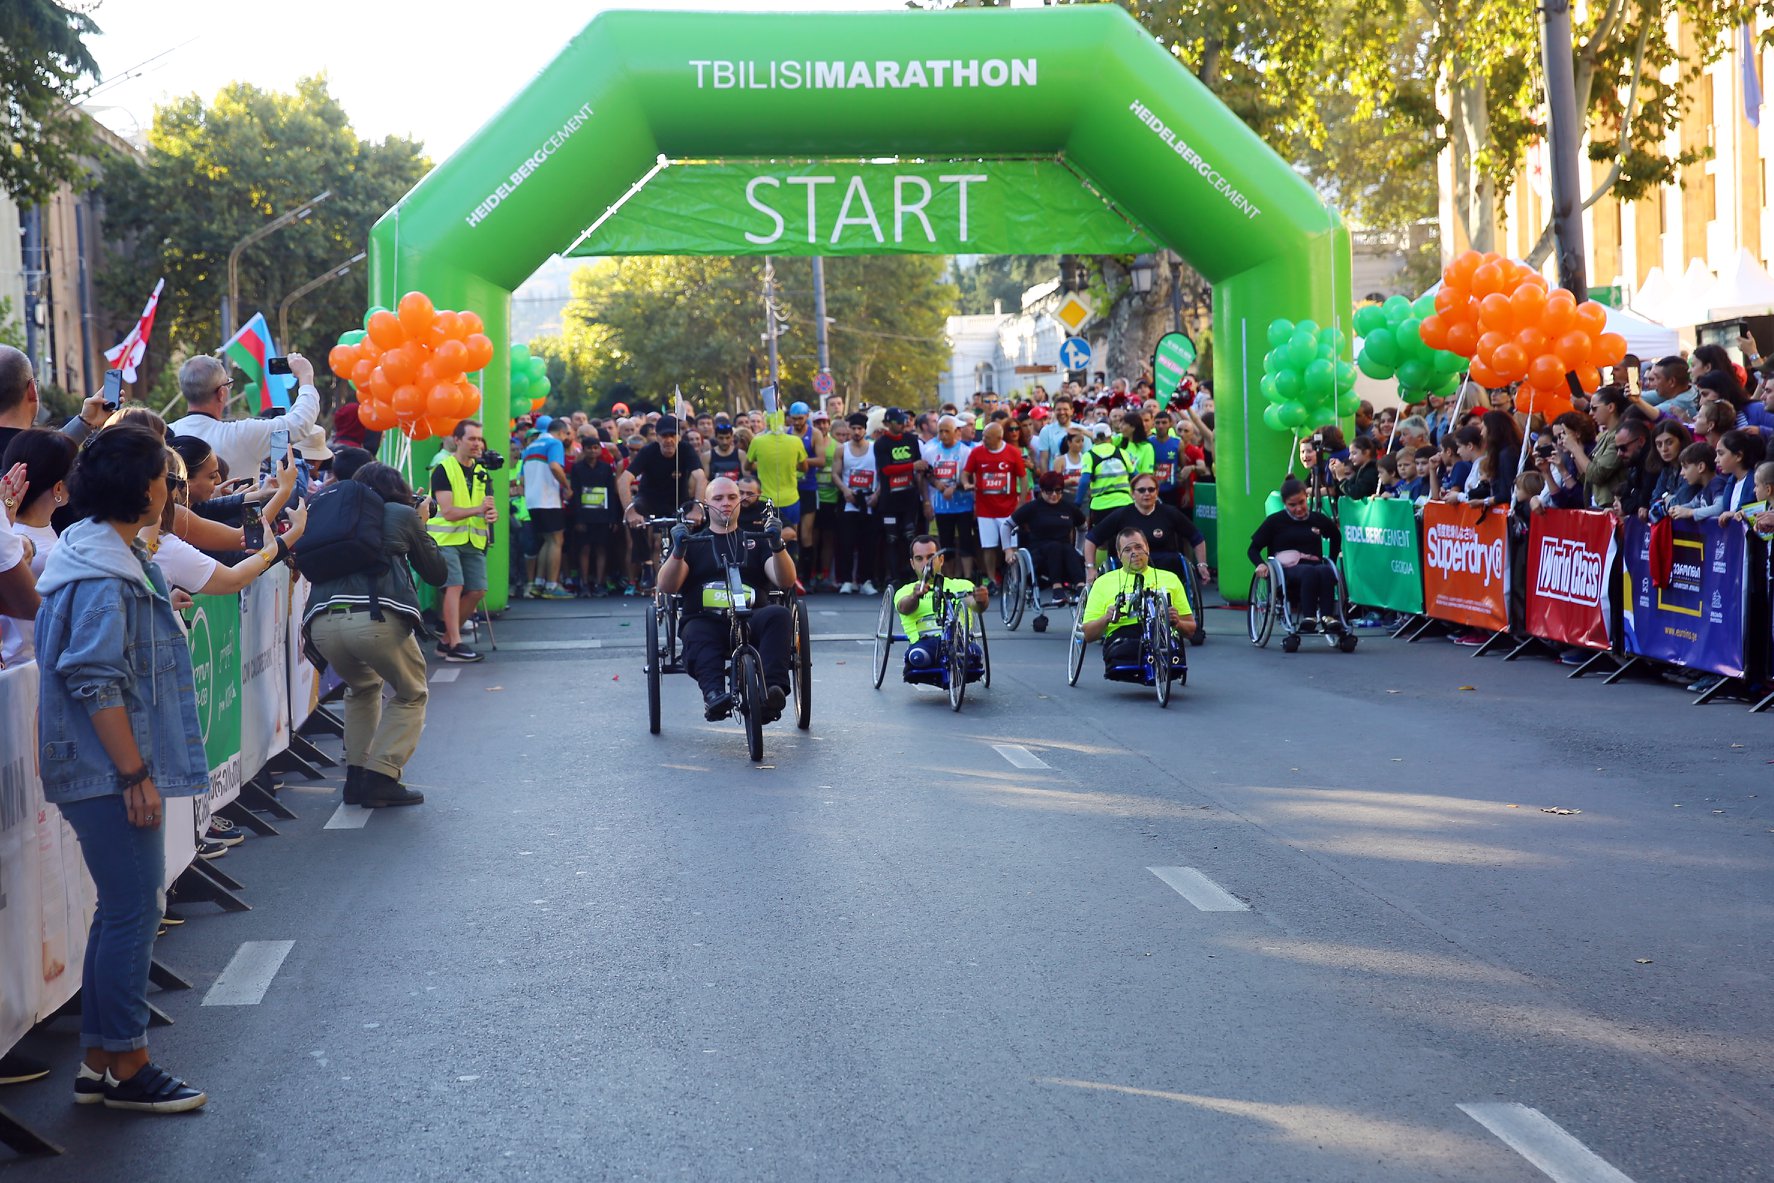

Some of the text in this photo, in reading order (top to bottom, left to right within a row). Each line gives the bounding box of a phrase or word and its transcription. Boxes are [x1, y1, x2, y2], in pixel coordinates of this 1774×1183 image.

[688, 58, 1038, 89] TBILISIMARATHON
[465, 101, 595, 228] HEIDELBERGCEMENT
[1128, 98, 1262, 220] HEIDELBERGCEMENT
[744, 174, 988, 245] START
[1540, 544, 1599, 599] World Class
